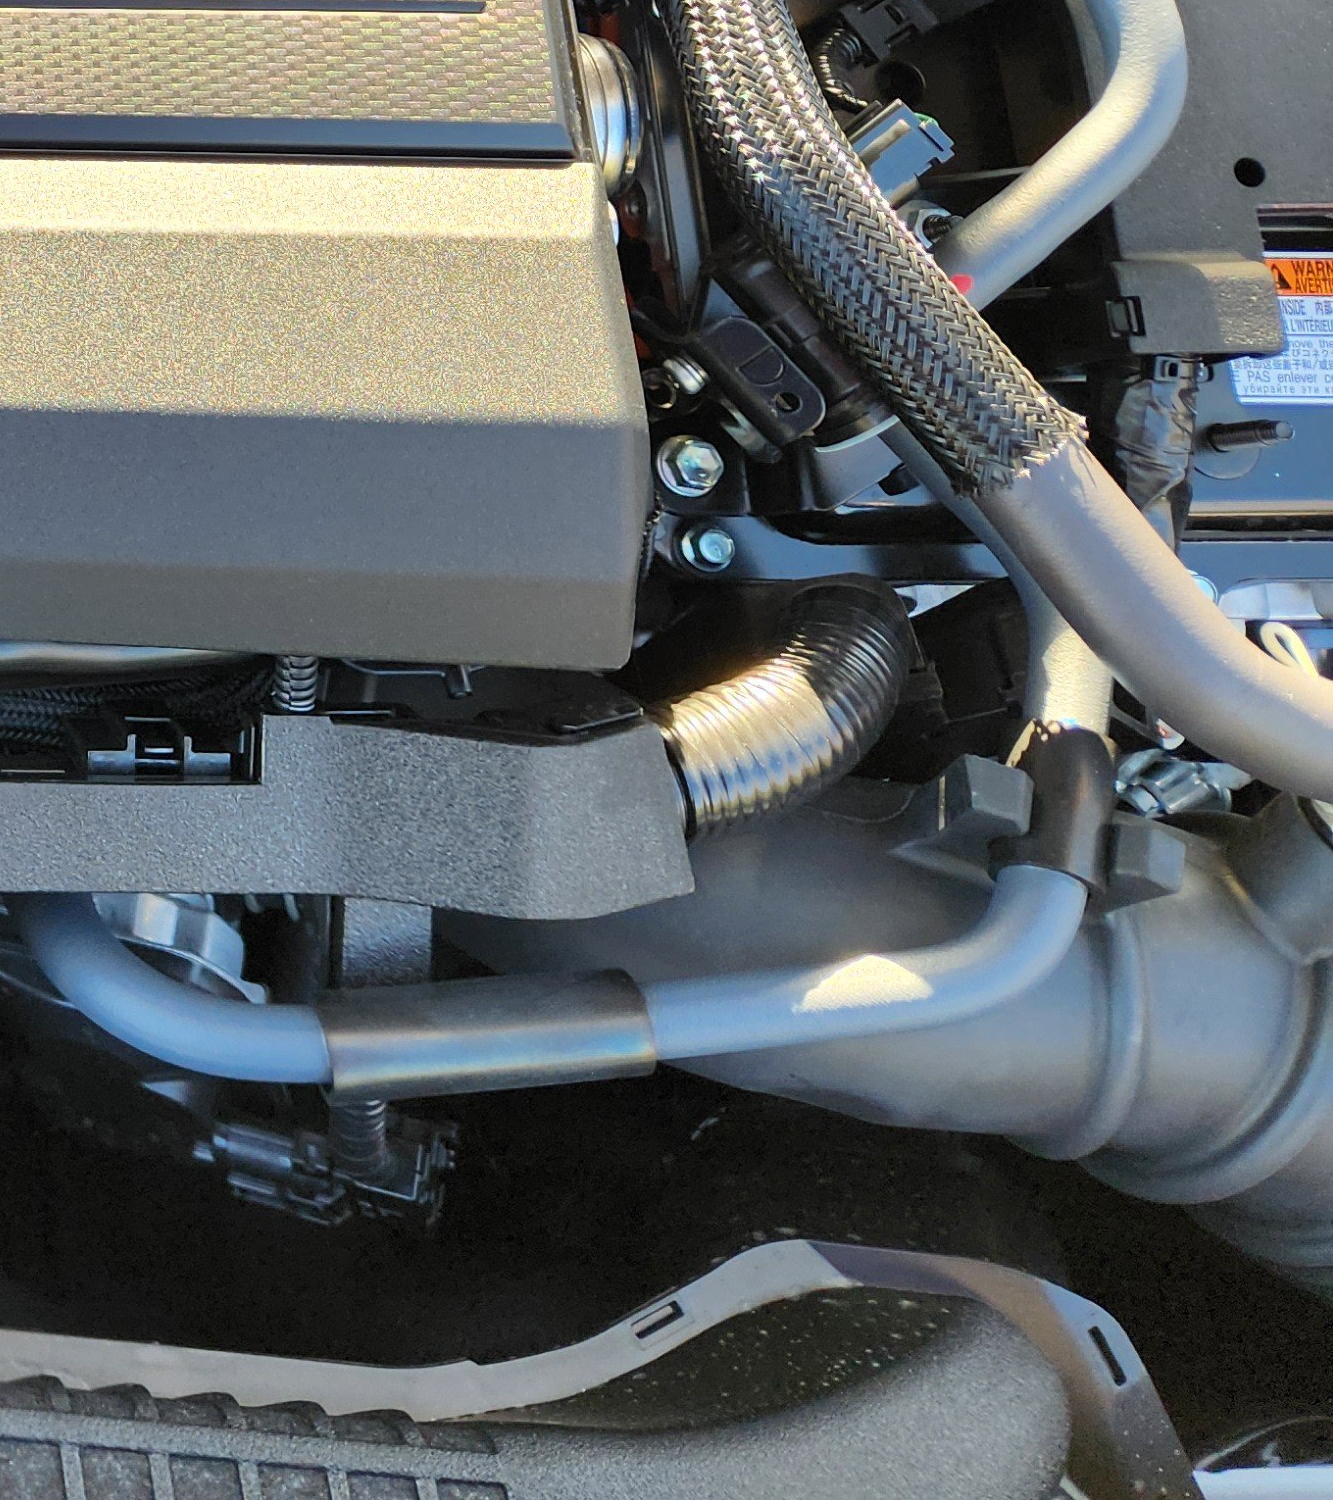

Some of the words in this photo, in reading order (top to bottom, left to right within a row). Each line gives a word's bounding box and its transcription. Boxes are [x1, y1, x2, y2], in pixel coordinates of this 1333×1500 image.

[1294, 277, 1333, 294] AVERTI
[1280, 299, 1307, 315] NSIDE
[1246, 369, 1272, 383] PAS
[1277, 370, 1318, 383] enlever
